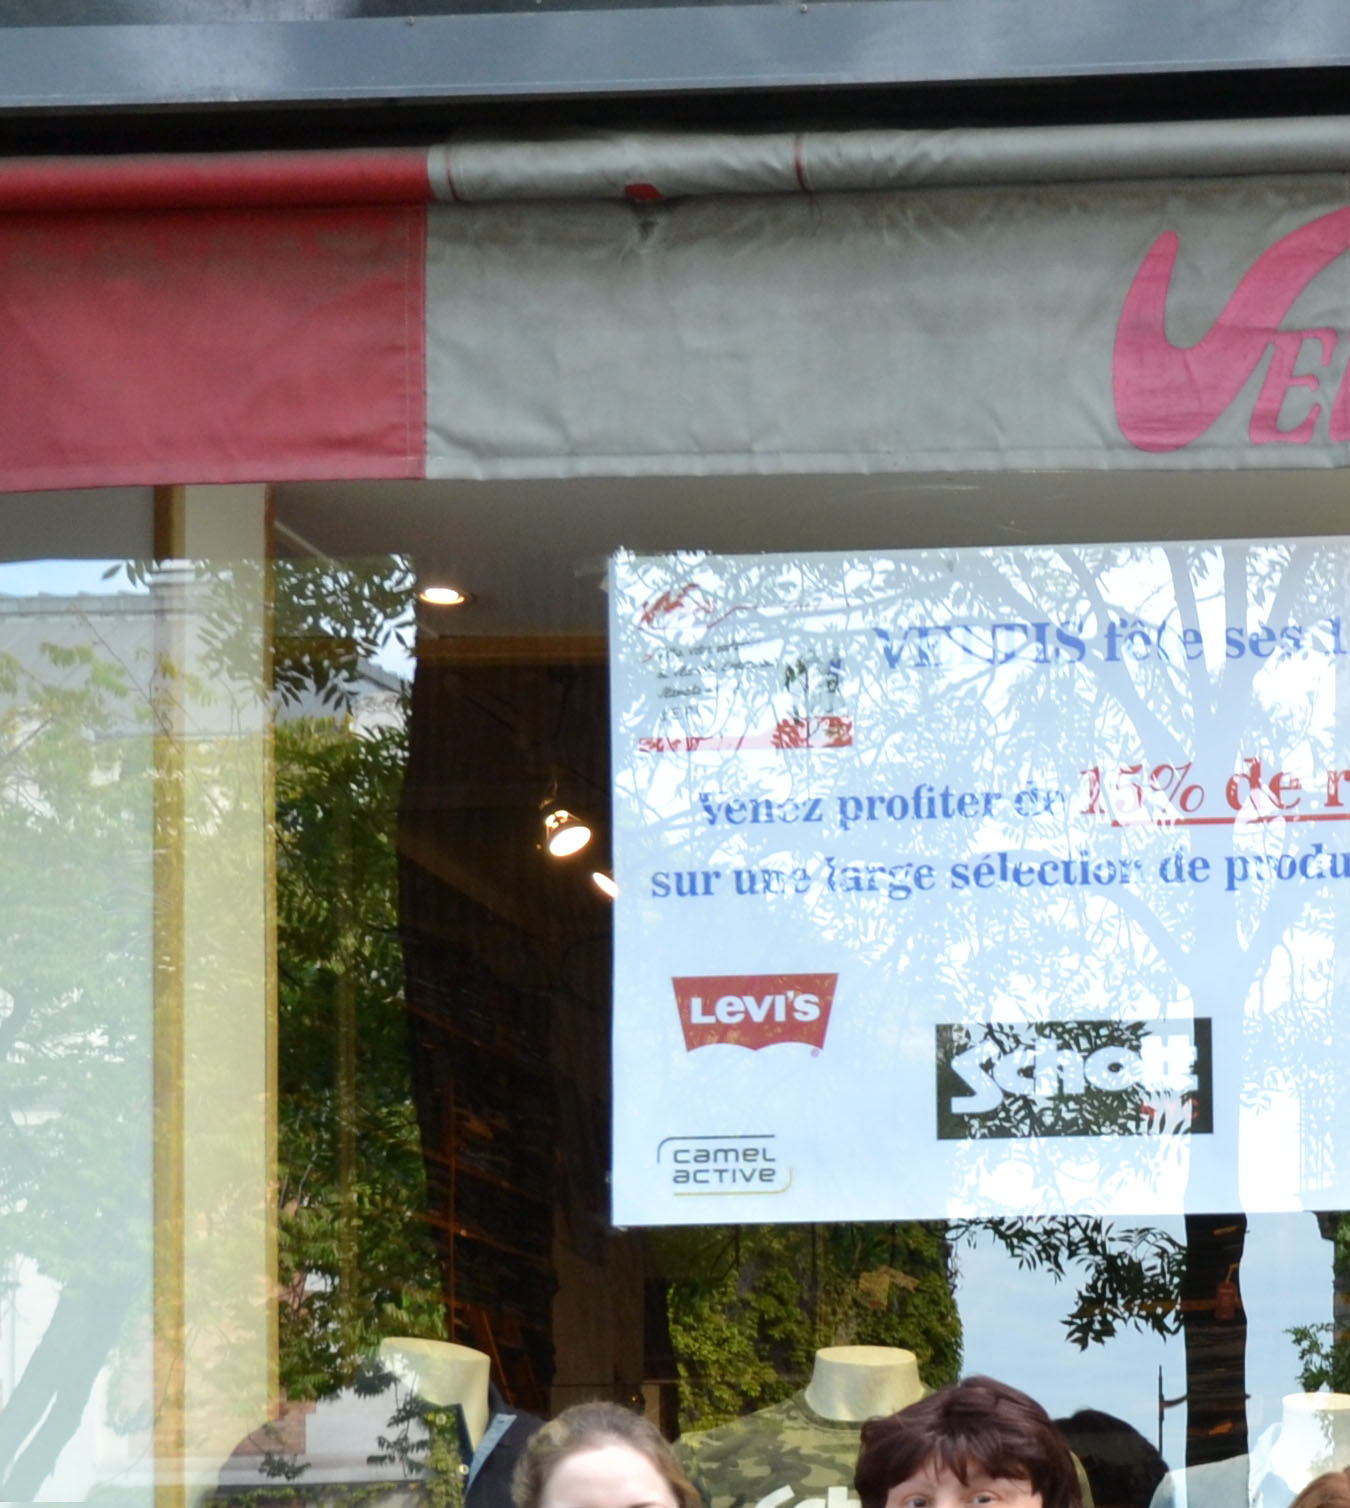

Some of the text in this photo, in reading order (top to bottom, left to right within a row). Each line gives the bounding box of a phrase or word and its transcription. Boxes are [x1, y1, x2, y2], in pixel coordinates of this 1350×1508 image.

[1225, 623, 1302, 659] ses
[837, 782, 1002, 831] profiter
[1080, 761, 1205, 815] 15%
[1225, 757, 1302, 811] de
[651, 868, 720, 897] sur
[732, 866, 811, 895] une
[826, 856, 936, 901] large
[950, 850, 1143, 890] sélection
[1160, 845, 1211, 885] de
